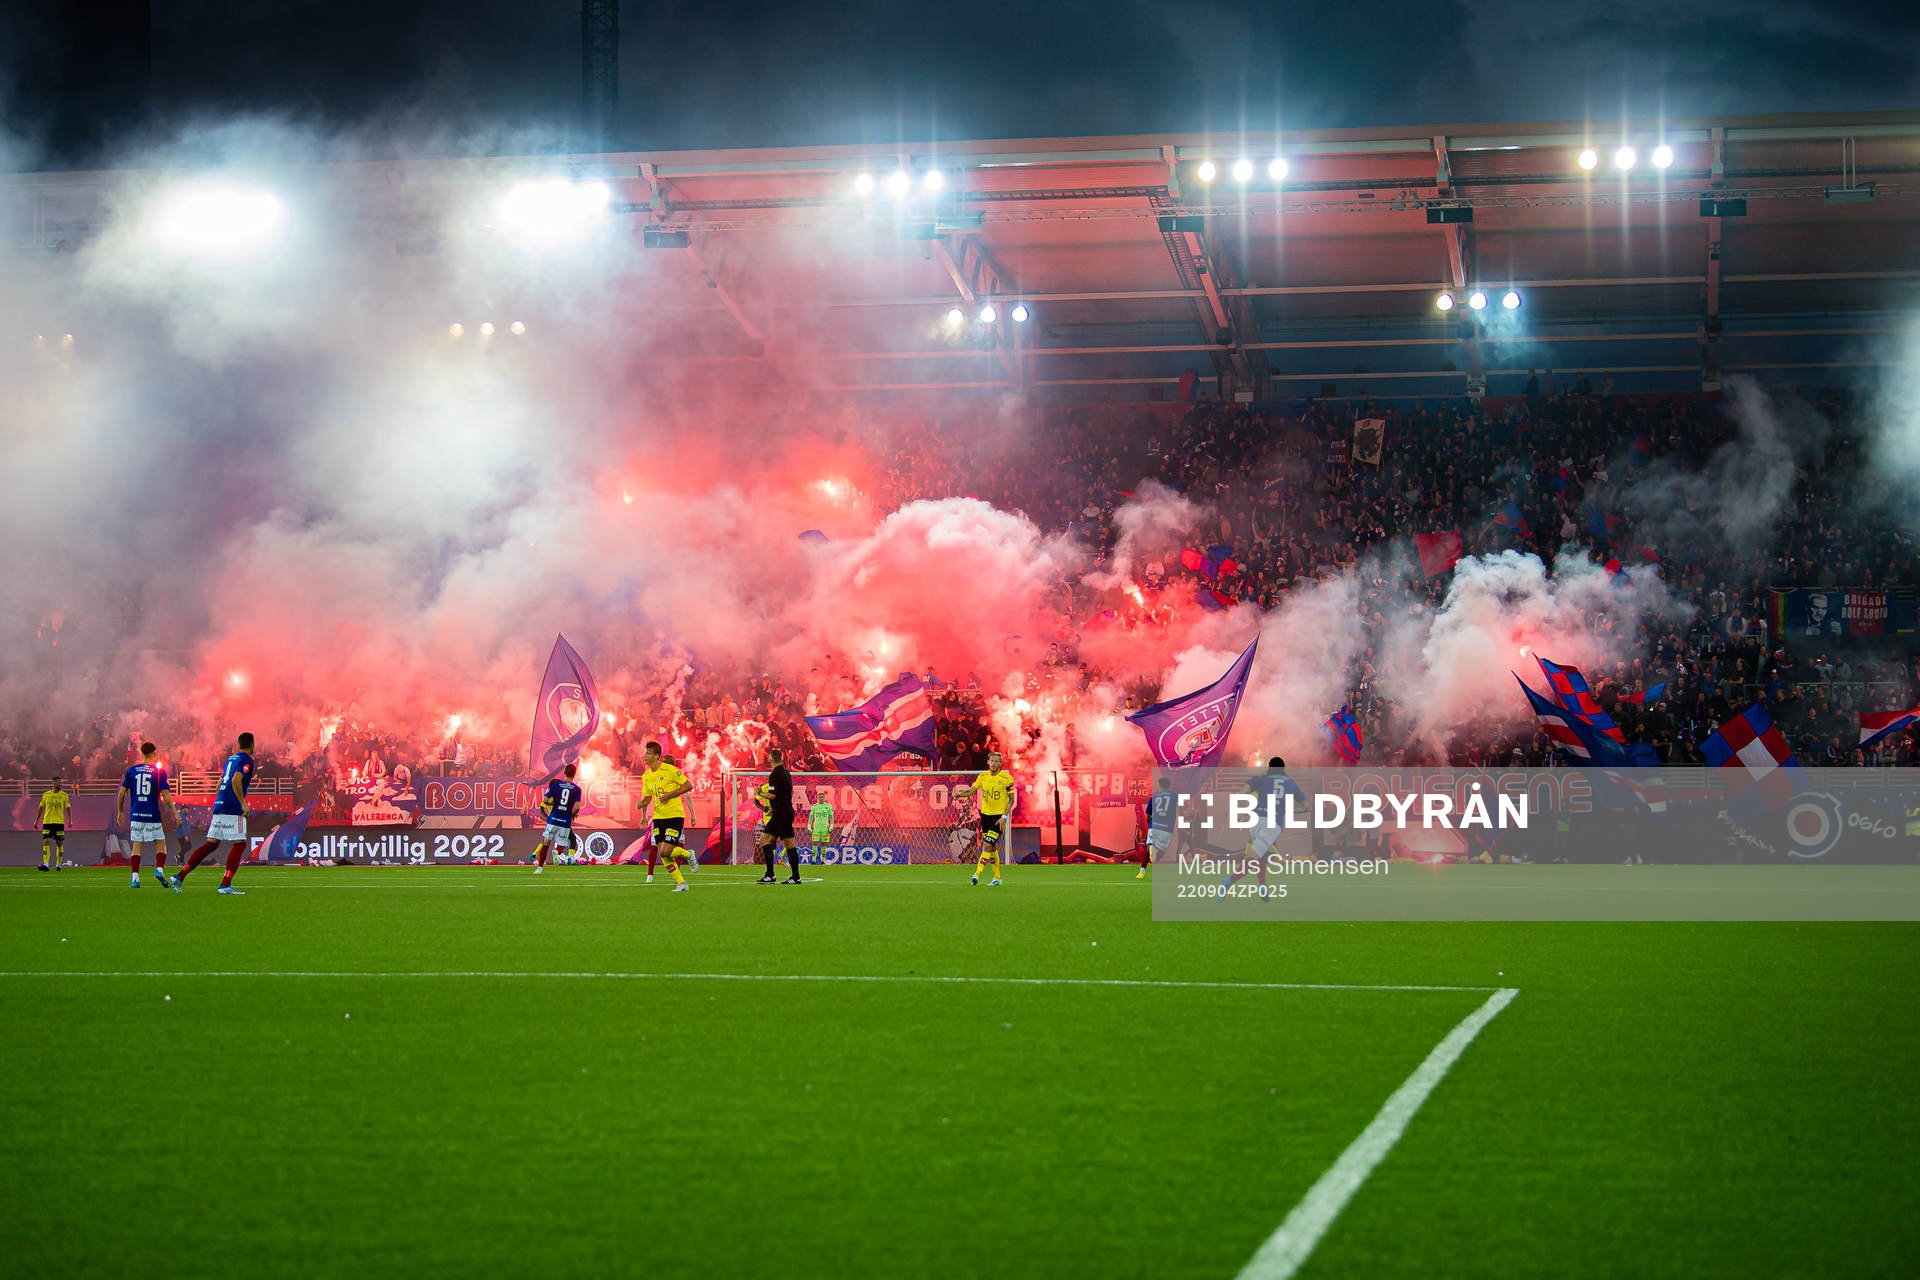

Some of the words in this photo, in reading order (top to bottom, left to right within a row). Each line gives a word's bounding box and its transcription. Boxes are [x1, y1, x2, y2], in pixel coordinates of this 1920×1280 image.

[1844, 594, 1888, 606] BRIGADE
[134, 773, 152, 796] 15
[345, 787, 367, 795] TRO
[1272, 778, 1285, 799] 5
[1321, 772, 1593, 815] BOHEMENE
[560, 788, 570, 806] 9
[1154, 796, 1171, 813] 27
[1847, 812, 1897, 839] OSLO
[433, 834, 505, 858] 2022
[821, 847, 894, 865] OBOS
